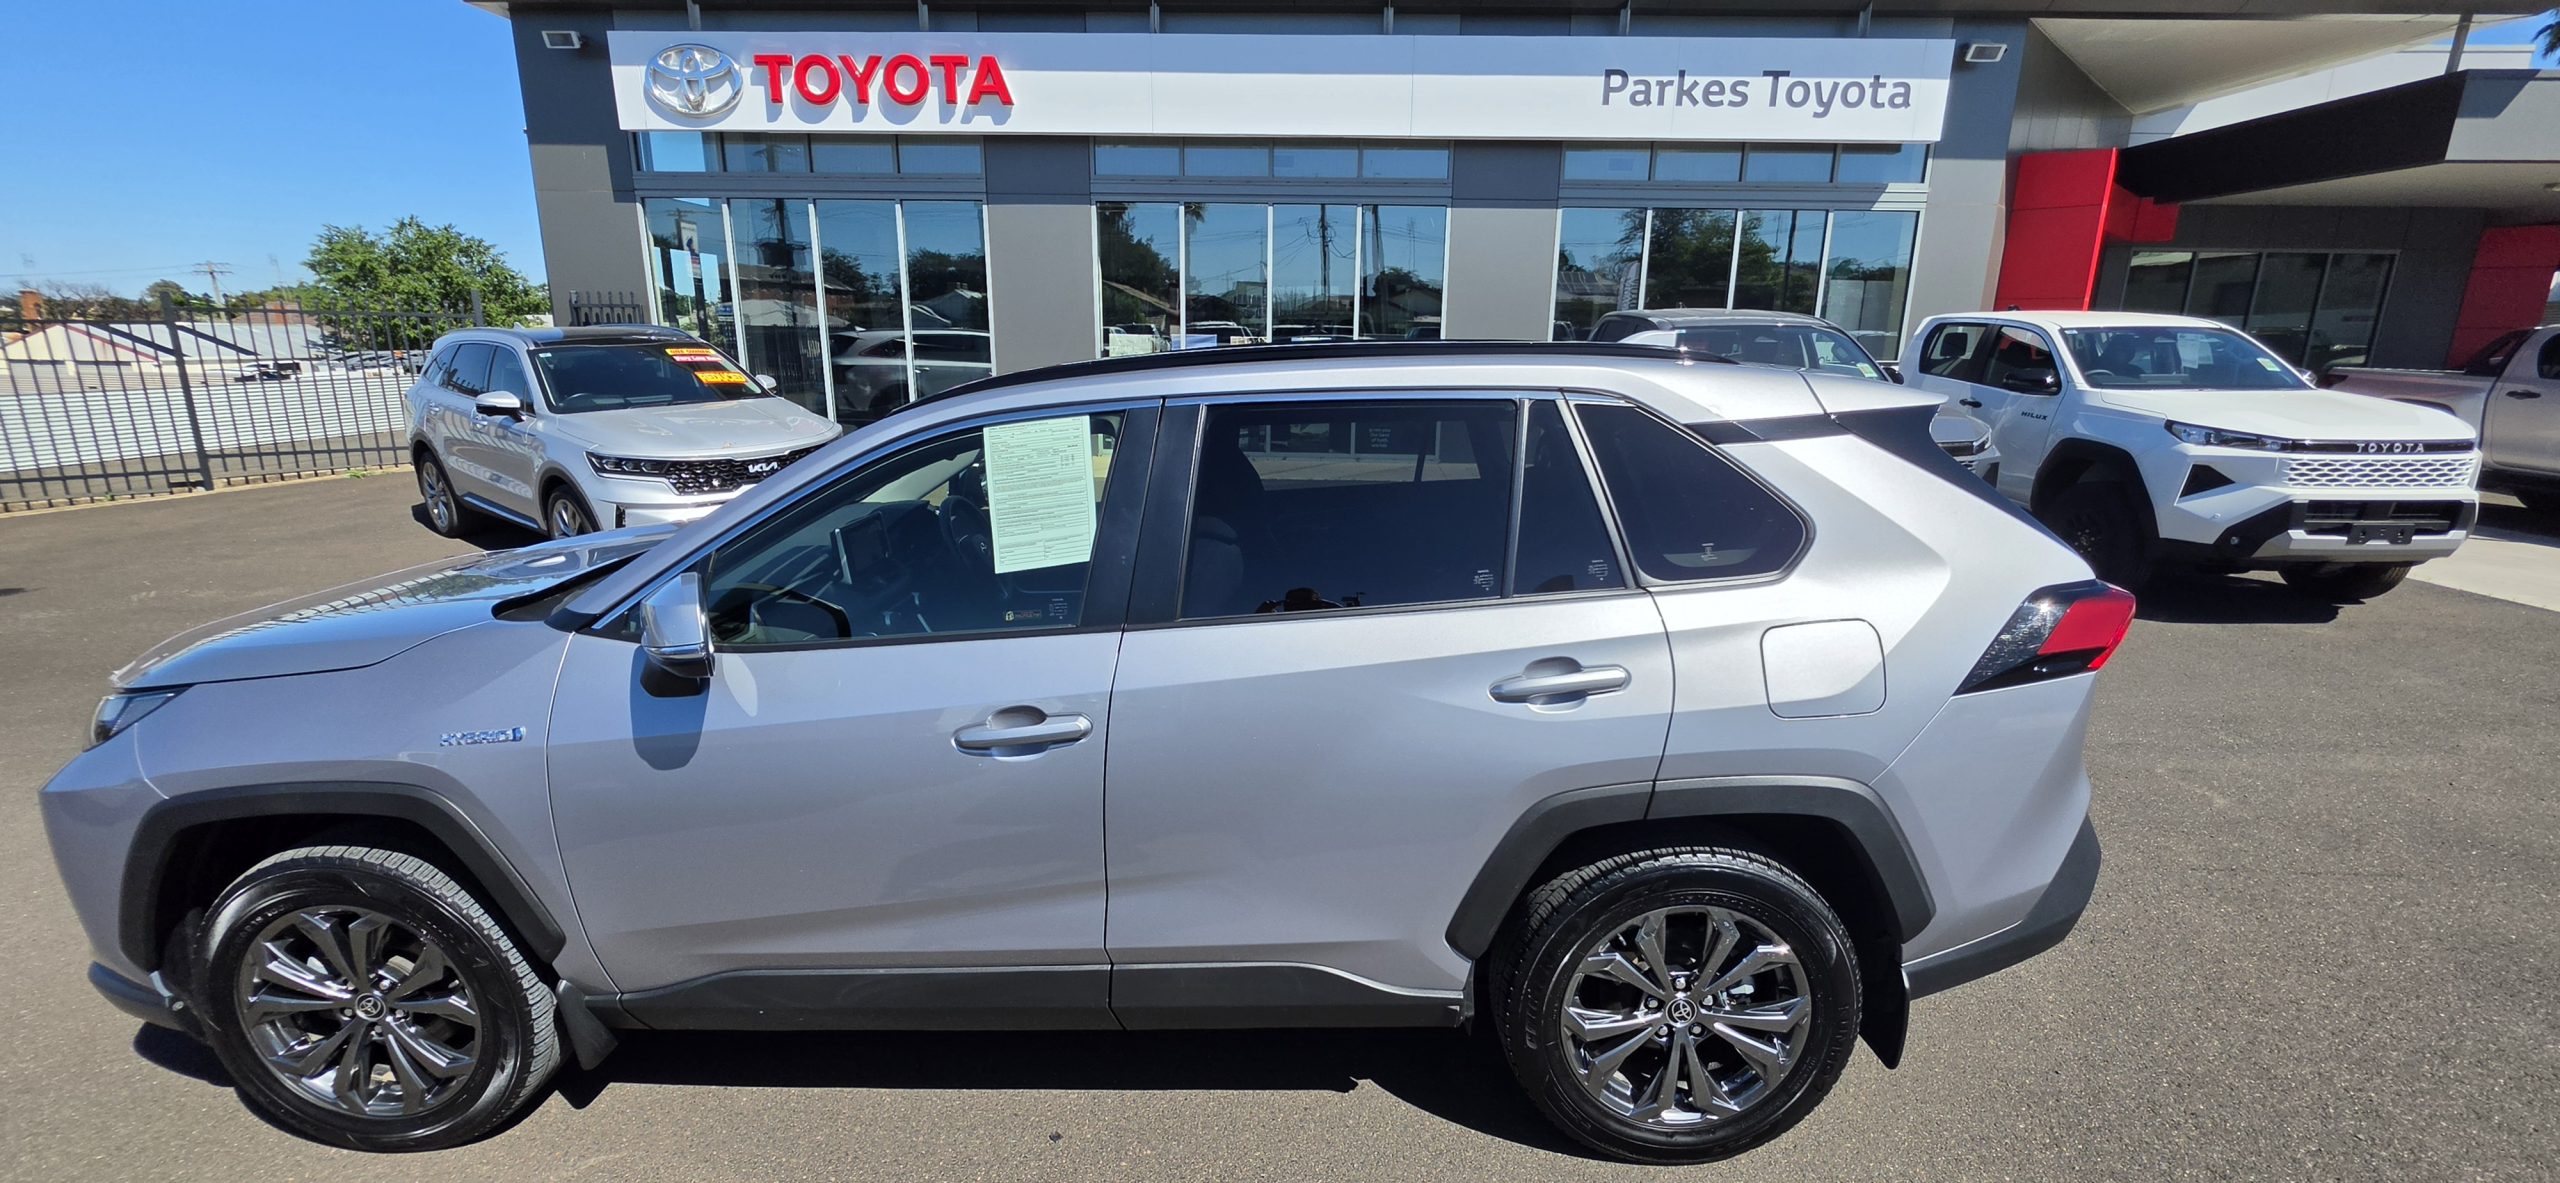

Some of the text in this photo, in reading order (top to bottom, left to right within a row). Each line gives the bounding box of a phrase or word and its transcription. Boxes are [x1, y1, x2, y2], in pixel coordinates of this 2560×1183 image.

[753, 53, 1015, 106] TOYOTA
[1602, 68, 1912, 118] Parkes Toyota
[2021, 411, 2048, 420] HILUX
[2355, 442, 2426, 454] TOYOTA
[747, 461, 778, 473] KIA
